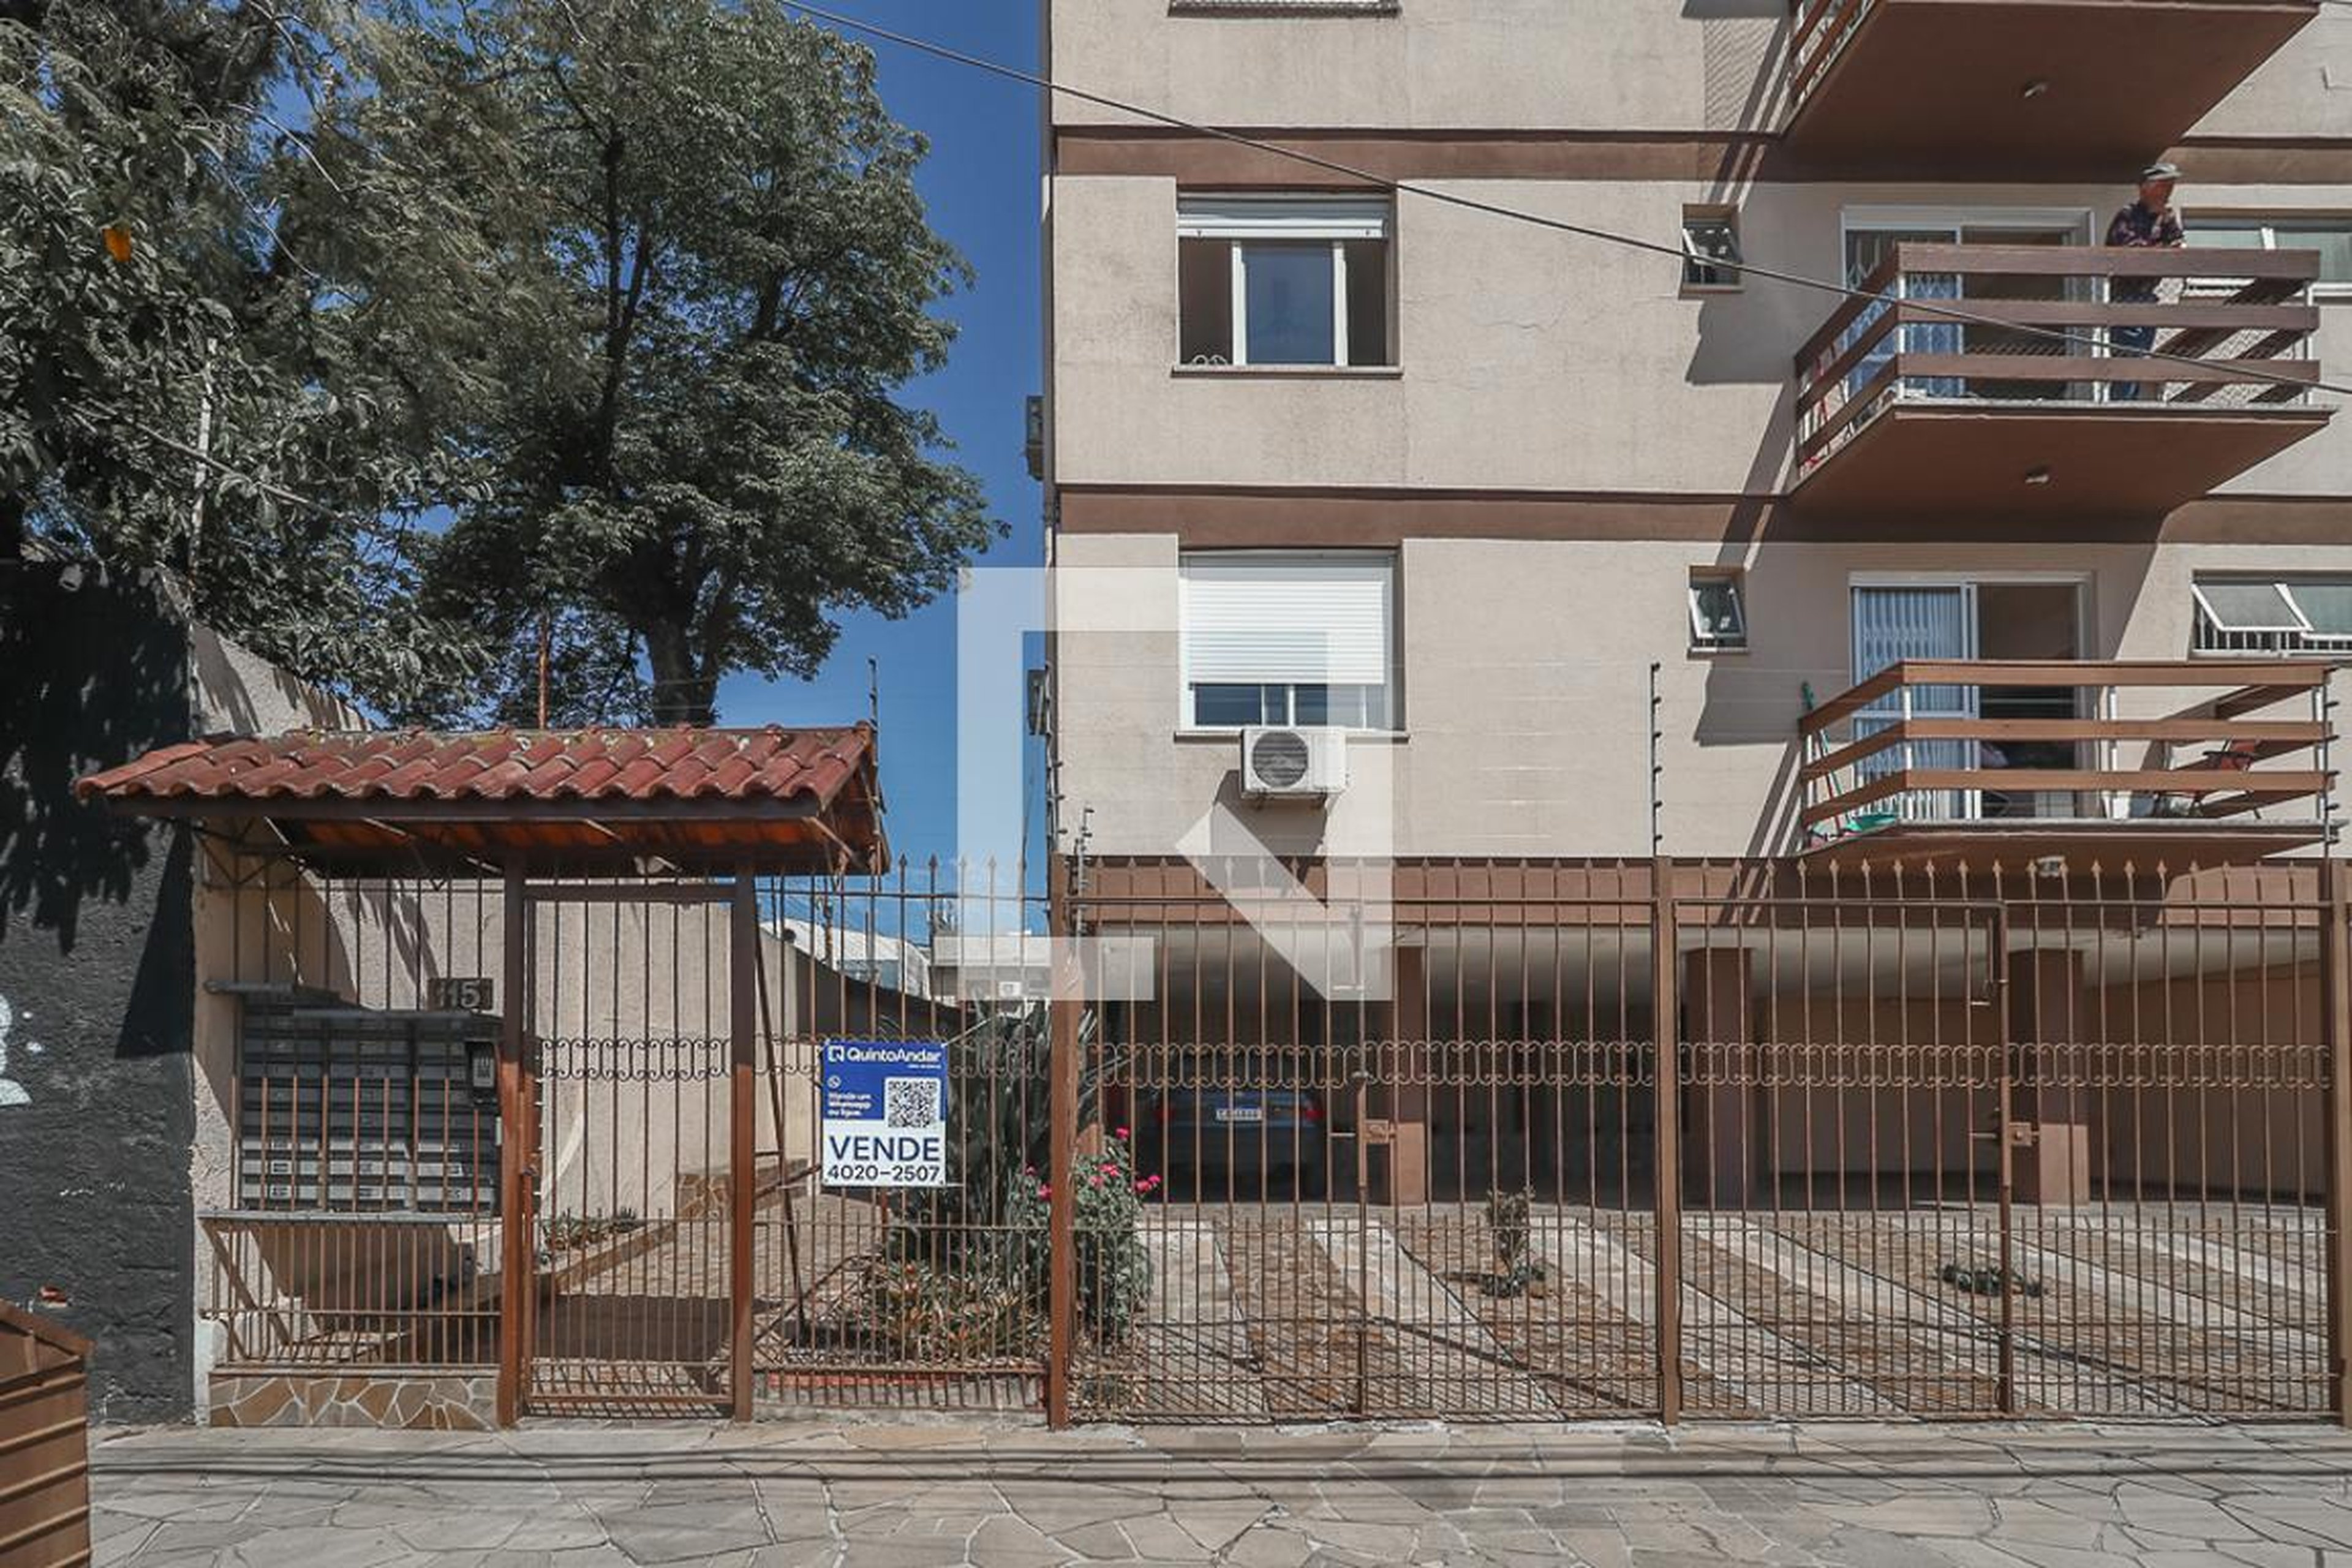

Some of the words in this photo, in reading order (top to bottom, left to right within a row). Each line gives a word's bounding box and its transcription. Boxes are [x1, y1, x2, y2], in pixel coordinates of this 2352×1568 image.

[847, 1047, 941, 1062] QuintoAndar
[829, 1136, 940, 1162] VENDE
[828, 1165, 941, 1182] 4020-2507
